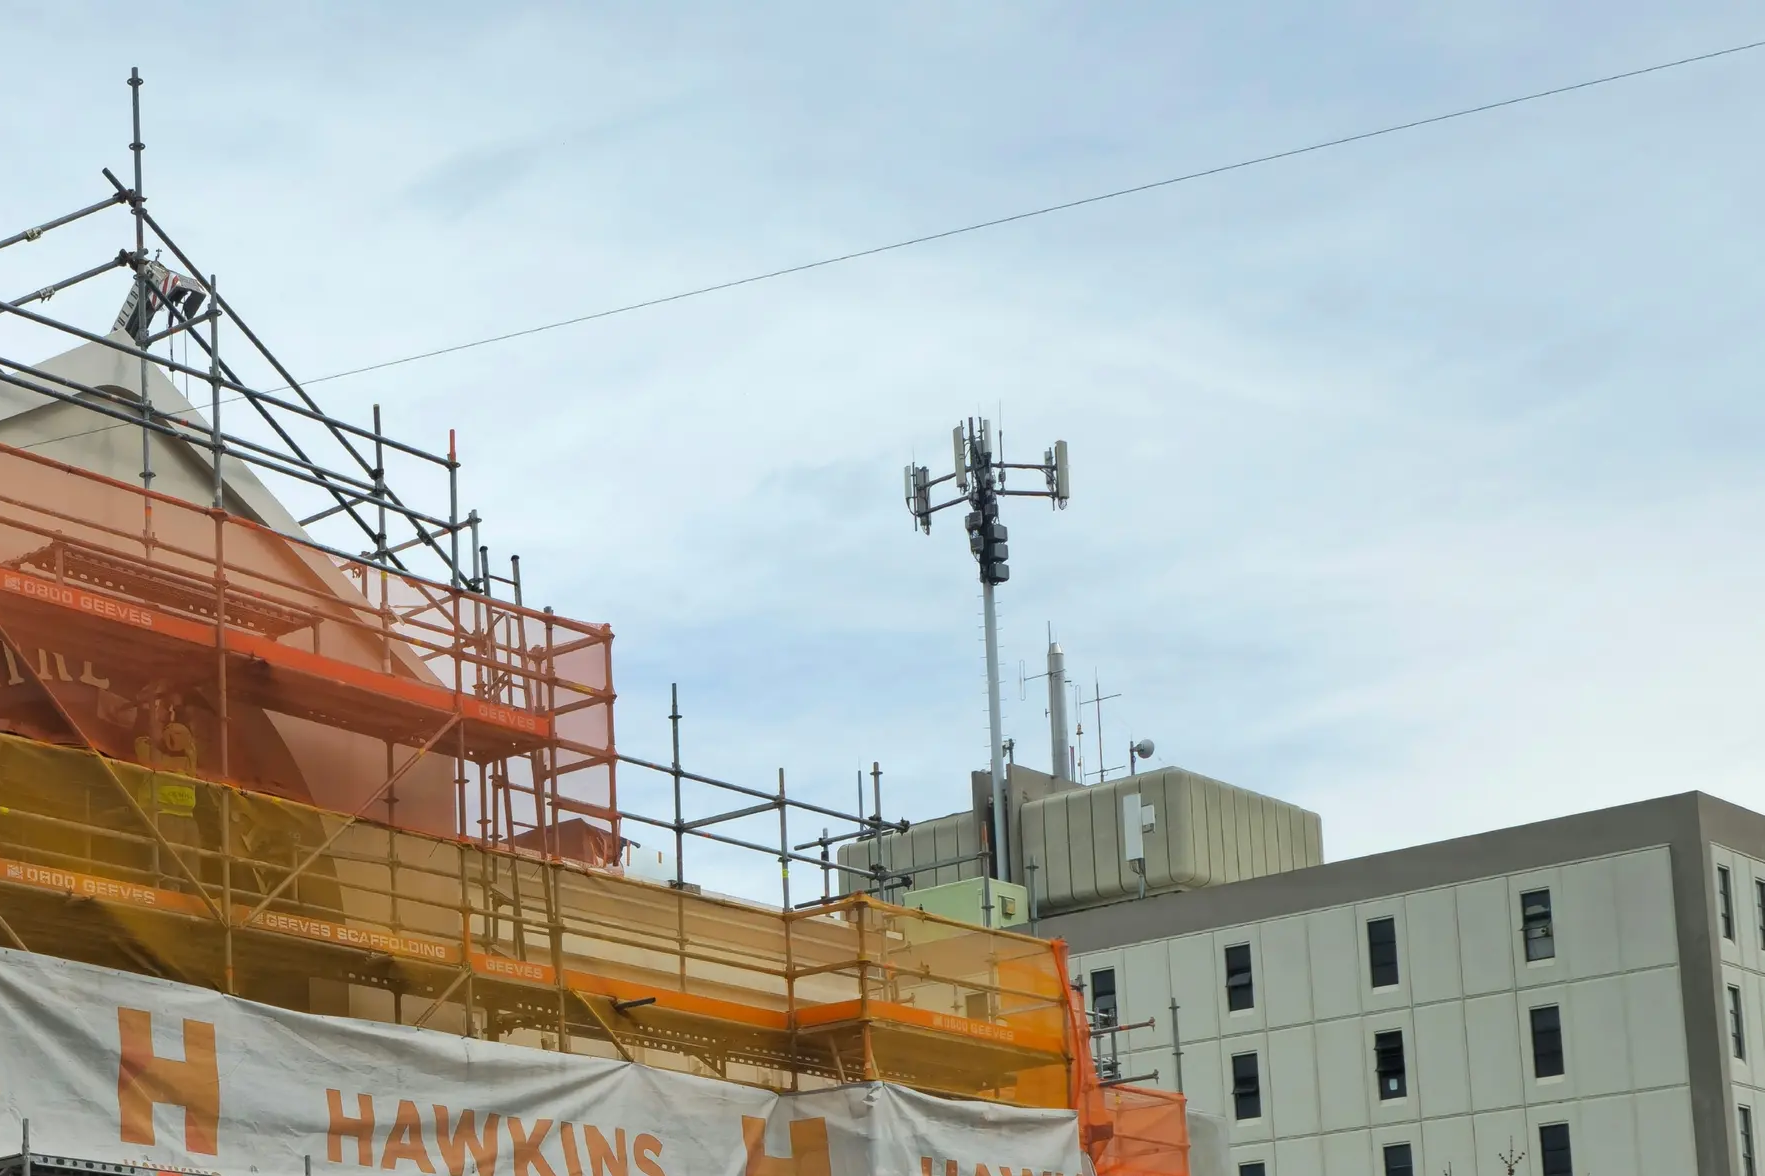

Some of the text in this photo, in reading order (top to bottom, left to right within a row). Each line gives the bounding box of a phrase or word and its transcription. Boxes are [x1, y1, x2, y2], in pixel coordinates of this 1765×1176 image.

[23, 581, 153, 627] 0800 GEEVES
[477, 703, 537, 732] GEEVES
[25, 867, 156, 906] 0800 GEEVES
[266, 910, 447, 958] GEEVES SCAFFOLDING
[485, 958, 544, 981] GEEVES
[970, 1022, 1015, 1041] GEEVES
[117, 1005, 221, 1157] H
